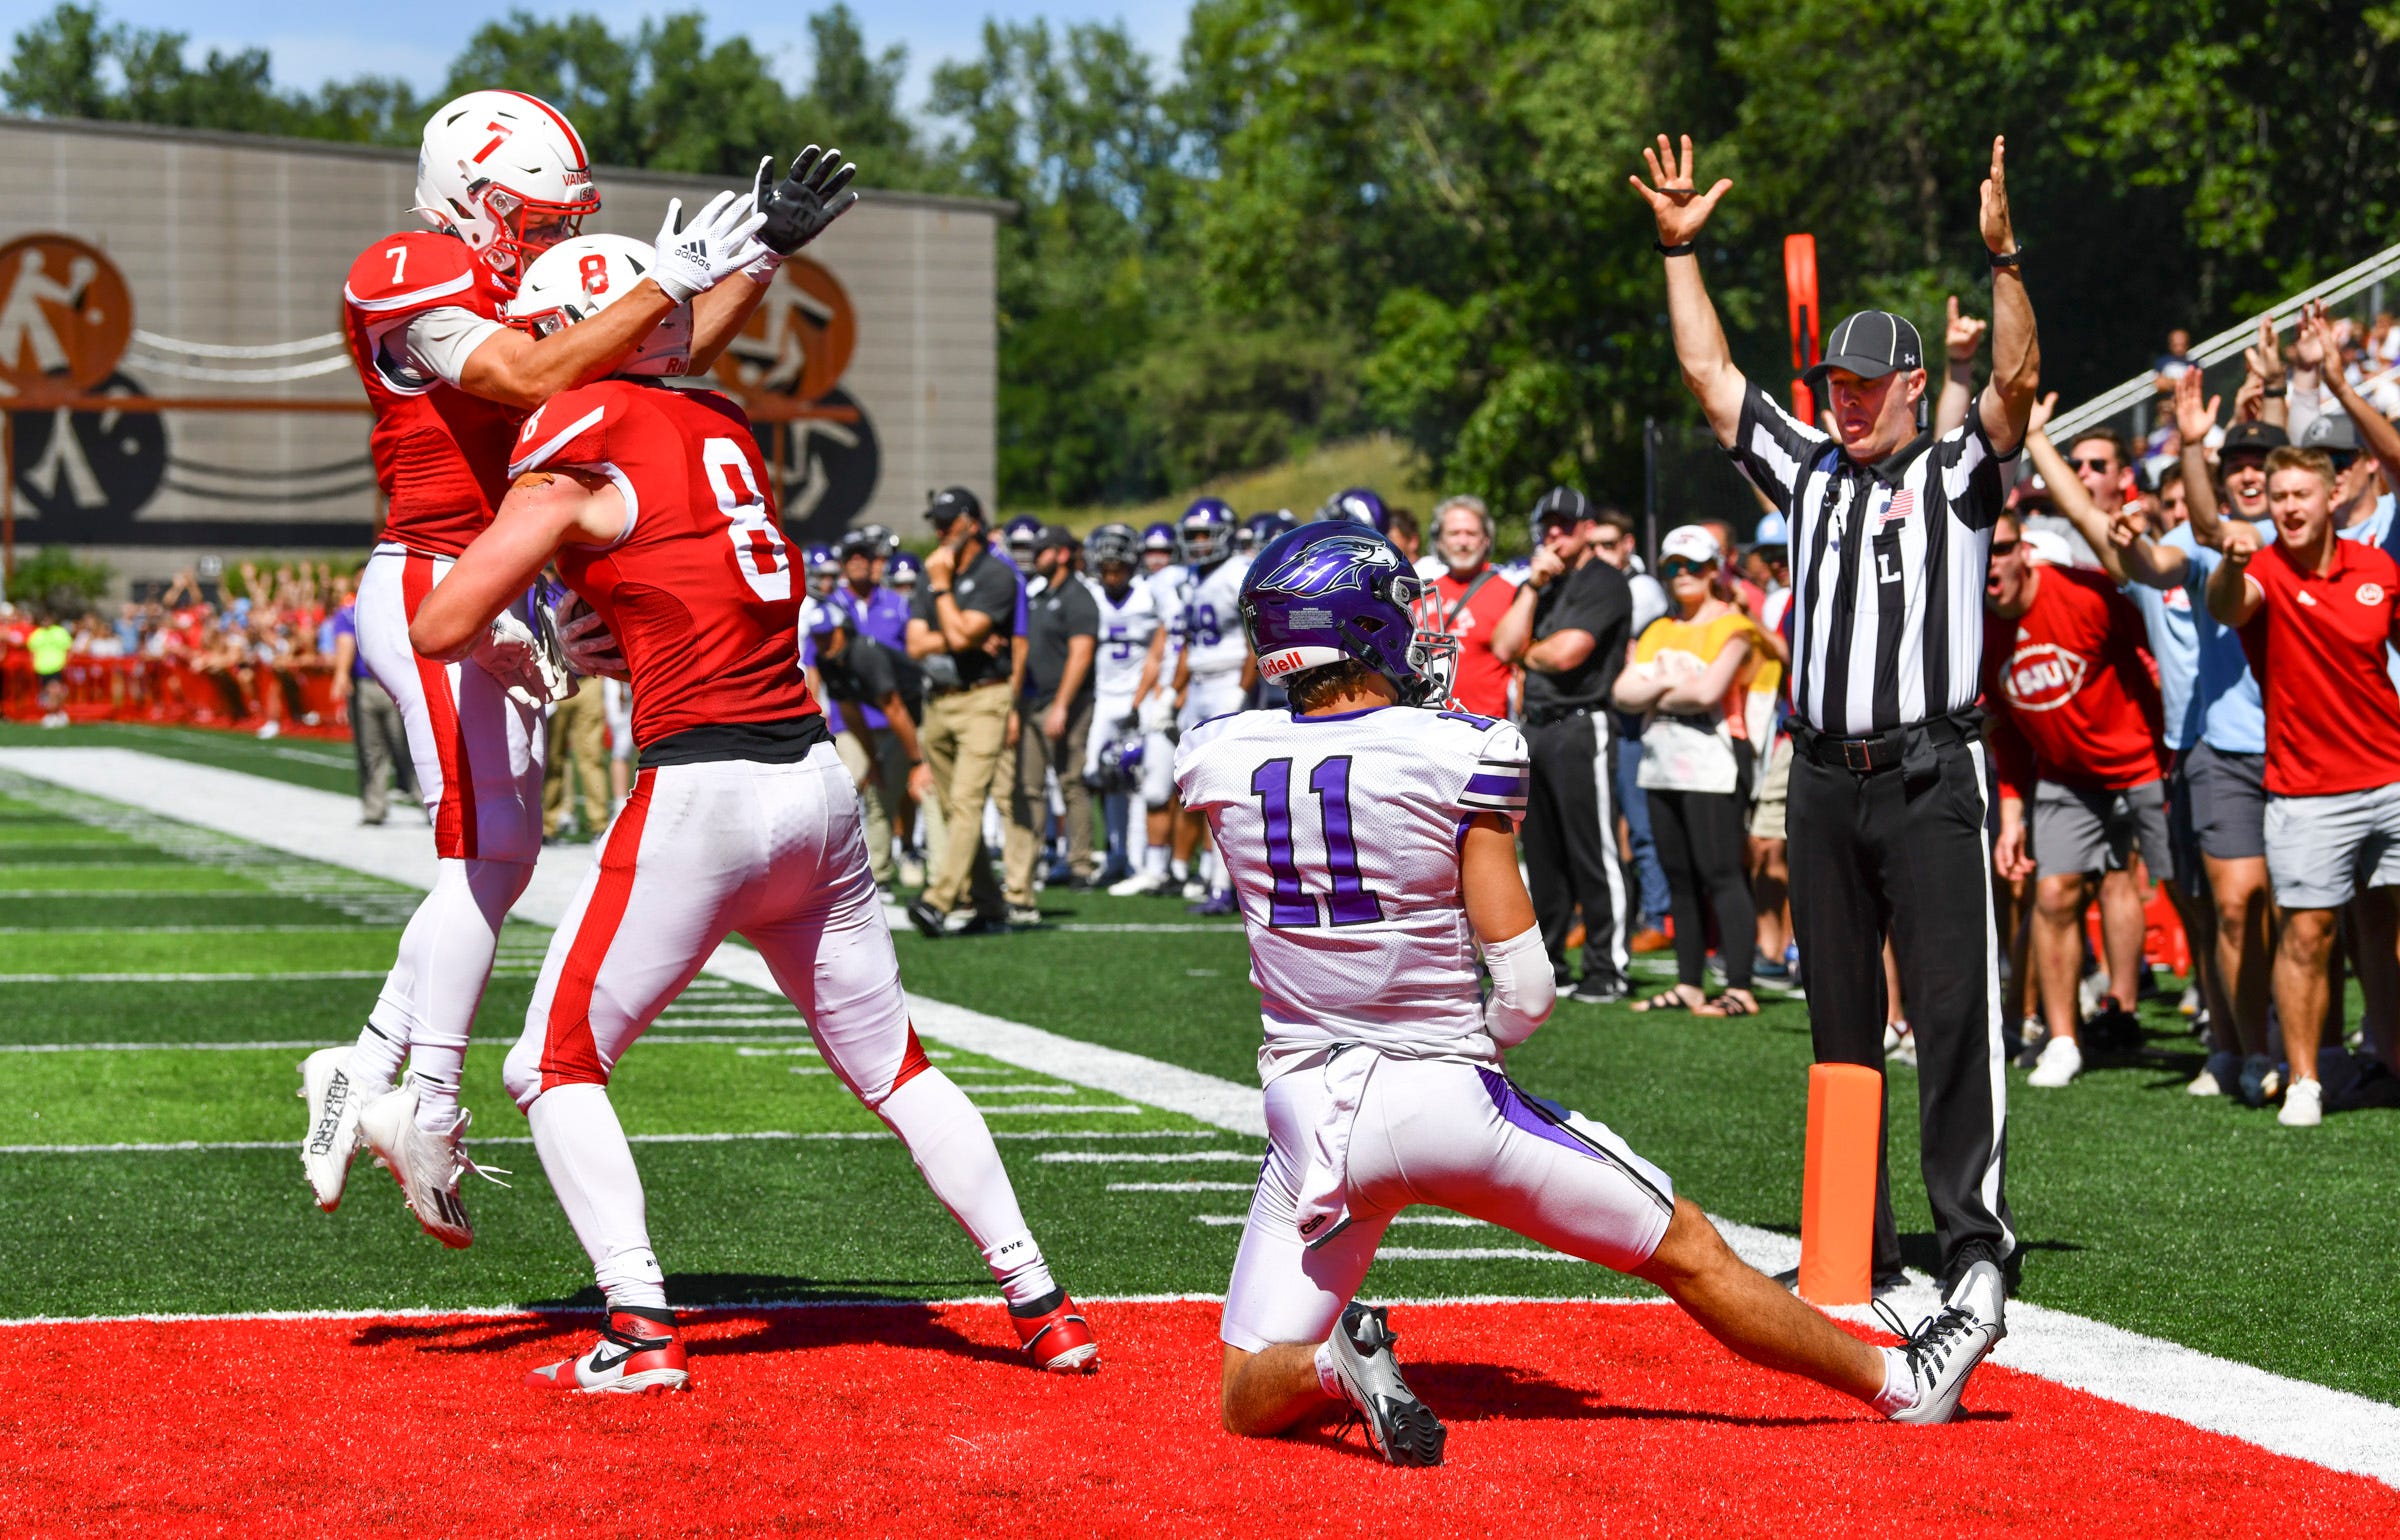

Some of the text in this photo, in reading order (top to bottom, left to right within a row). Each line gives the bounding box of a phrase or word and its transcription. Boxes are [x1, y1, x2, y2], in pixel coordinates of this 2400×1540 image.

[472, 121, 513, 164] 7
[386, 245, 407, 285] 7
[578, 253, 610, 296] 8
[674, 247, 712, 272] adidas
[521, 402, 546, 444] 8
[702, 437, 791, 602] 8
[1877, 553, 1902, 584] L
[1109, 625, 1130, 660] 5
[2015, 660, 2065, 696] SJU
[1250, 754, 1385, 929] 11
[309, 1067, 349, 1156] ADIZERO
[1000, 1240, 1024, 1254] BYE
